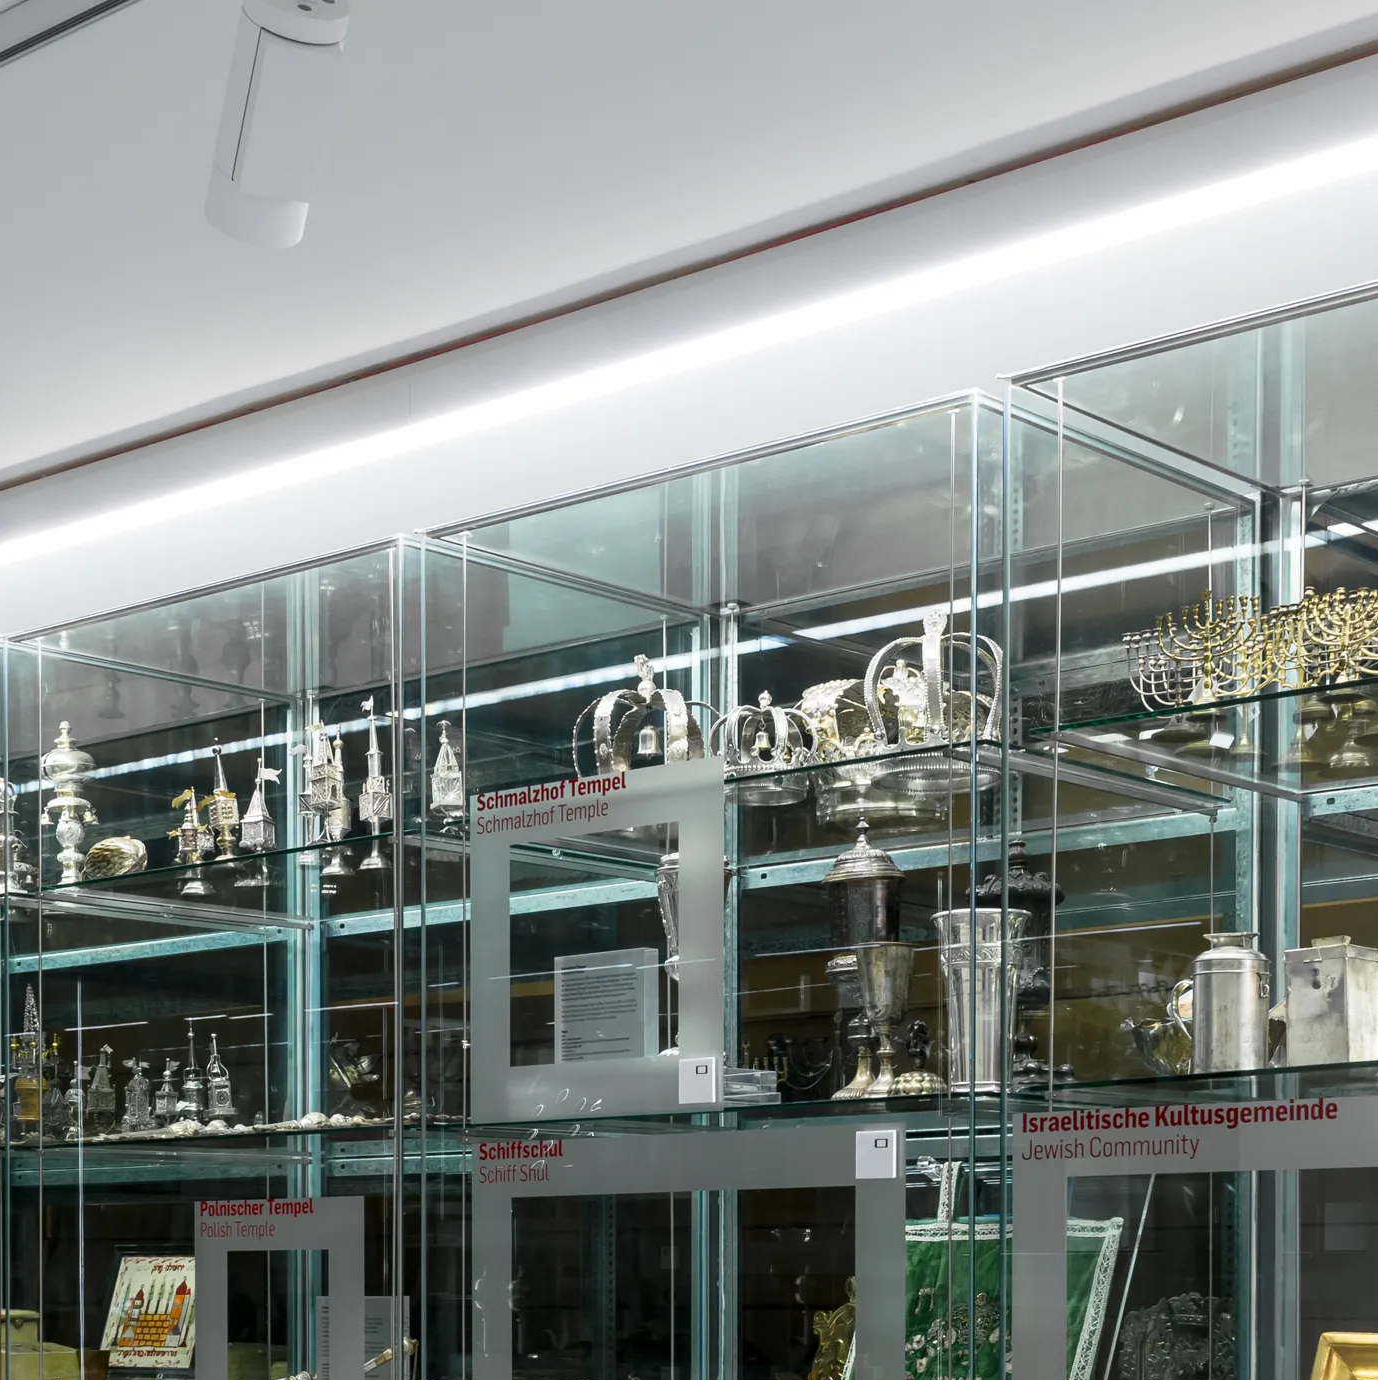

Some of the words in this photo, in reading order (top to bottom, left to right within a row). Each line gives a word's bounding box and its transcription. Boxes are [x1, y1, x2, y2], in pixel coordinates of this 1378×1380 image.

[477, 780, 566, 812] Schmalzhof
[569, 771, 627, 797] Tempel
[477, 806, 556, 835] Schmalzhof
[558, 799, 609, 823] Temple
[1022, 1107, 1150, 1134] Israelitische
[1154, 1099, 1339, 1129] Kultusgemeinde
[479, 1140, 564, 1161] Schiffschul
[1022, 1138, 1085, 1161] Jewish
[1089, 1132, 1200, 1160] Community
[479, 1164, 517, 1184] Schiff
[520, 1163, 550, 1183] Shul
[200, 1200, 264, 1217] Polnischer
[267, 1198, 314, 1218] Tempel
[200, 1221, 232, 1238] Polish
[234, 1220, 276, 1241] Temple
